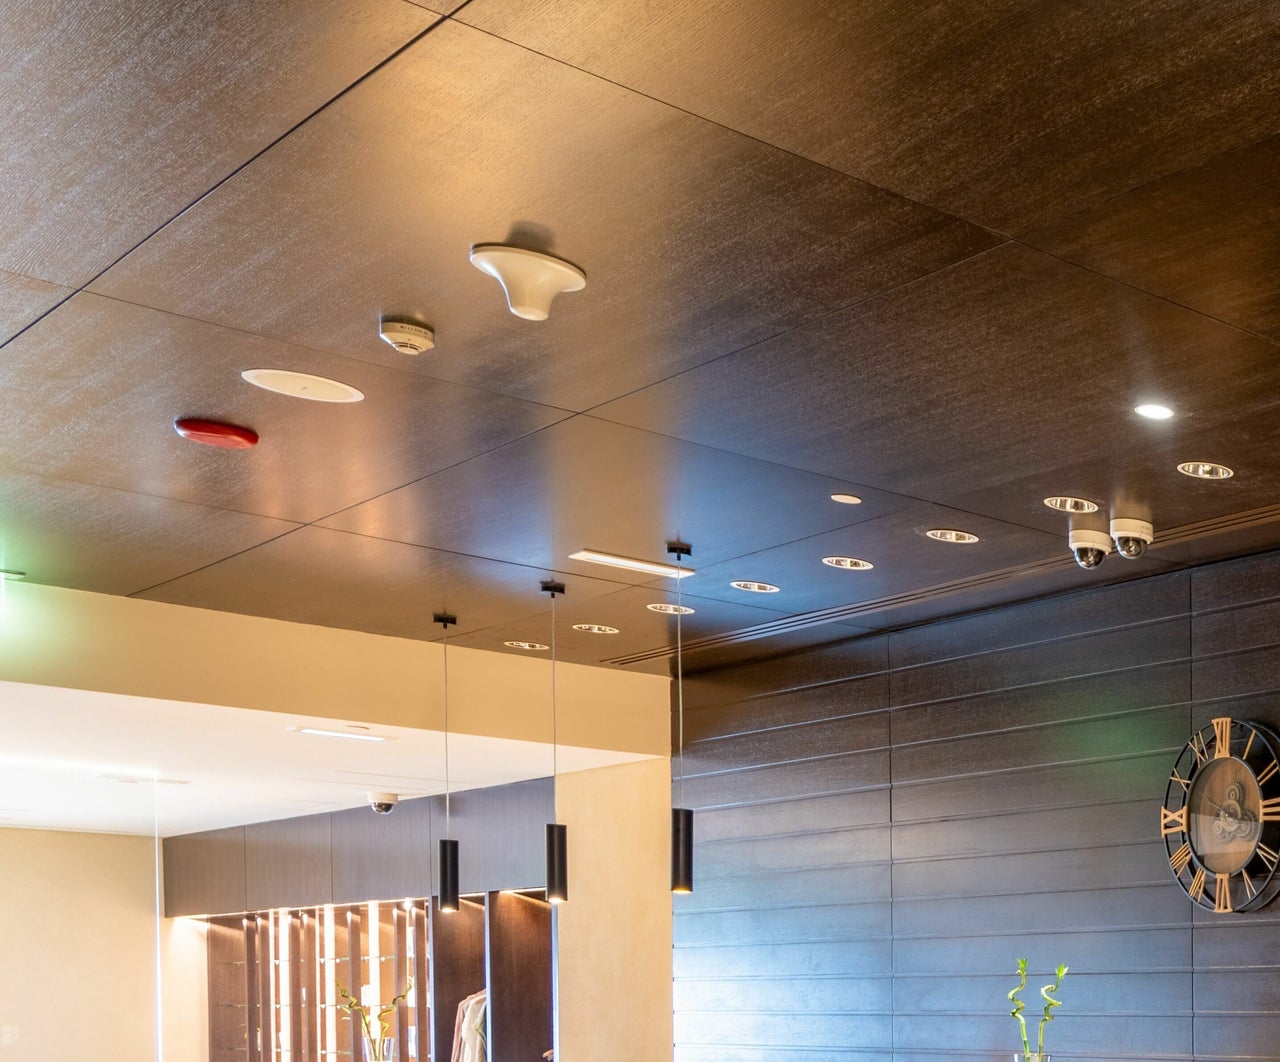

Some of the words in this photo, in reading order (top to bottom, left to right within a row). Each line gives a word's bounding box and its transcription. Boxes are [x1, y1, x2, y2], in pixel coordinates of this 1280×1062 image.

[1212, 717, 1232, 759] XII
[1169, 768, 1191, 792] X
[1161, 805, 1188, 838] IX
[1214, 873, 1233, 913] VI
